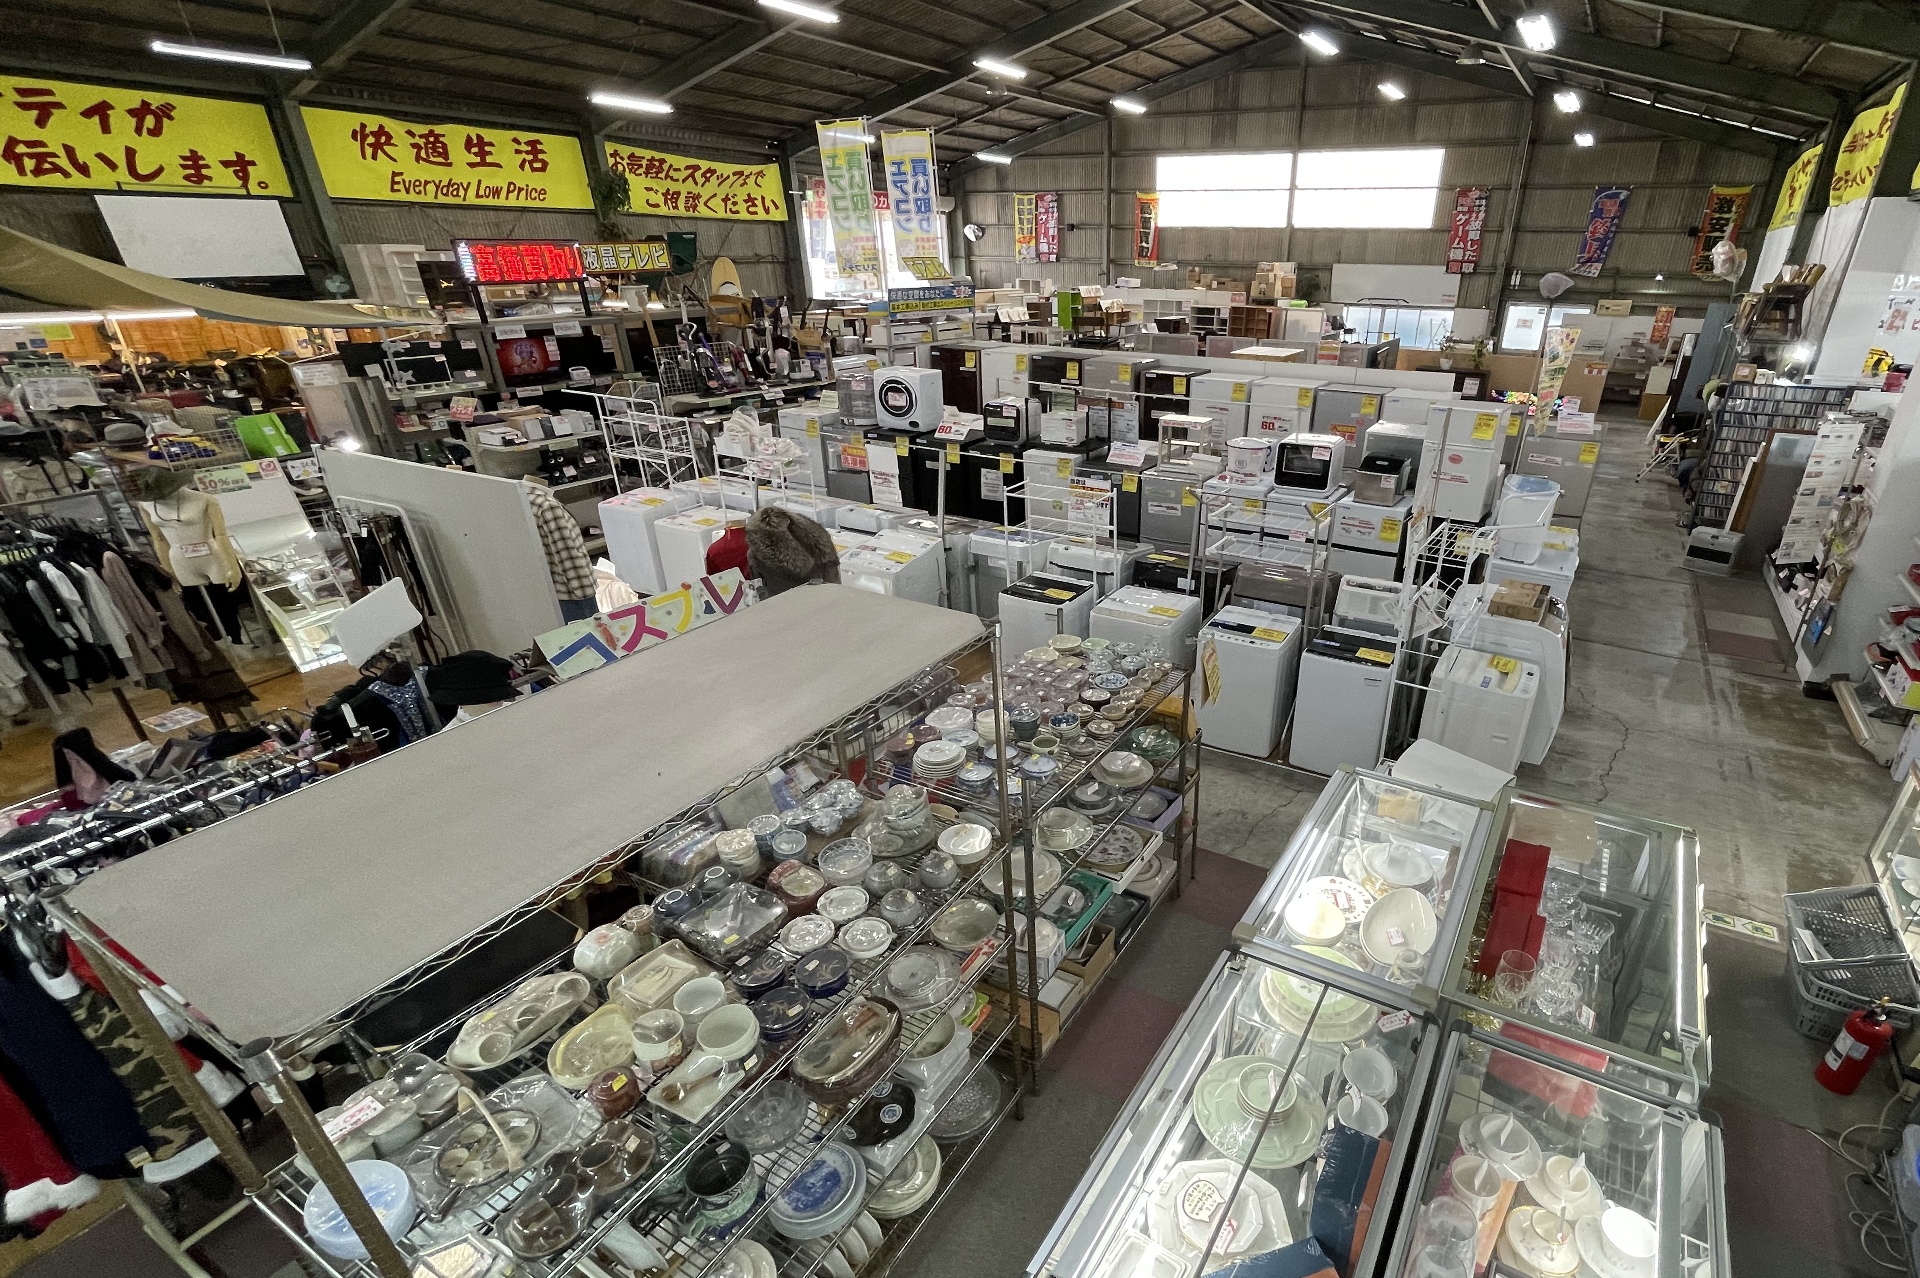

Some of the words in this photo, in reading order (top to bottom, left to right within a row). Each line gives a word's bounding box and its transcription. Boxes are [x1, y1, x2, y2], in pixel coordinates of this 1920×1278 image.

[0, 87, 177, 138] ティが
[0, 135, 270, 190] 伝いします。
[351, 122, 550, 174] 快適生活
[608, 149, 767, 189] お気軽にスタッフまで
[390, 171, 471, 201] Everyday
[475, 179, 503, 199] Low
[505, 182, 548, 201] Price
[644, 187, 780, 216] ご相談ください
[580, 243, 667, 270] 液晶テレビ
[451, 403, 476, 415] ステレオ
[431, 421, 447, 430] PC
